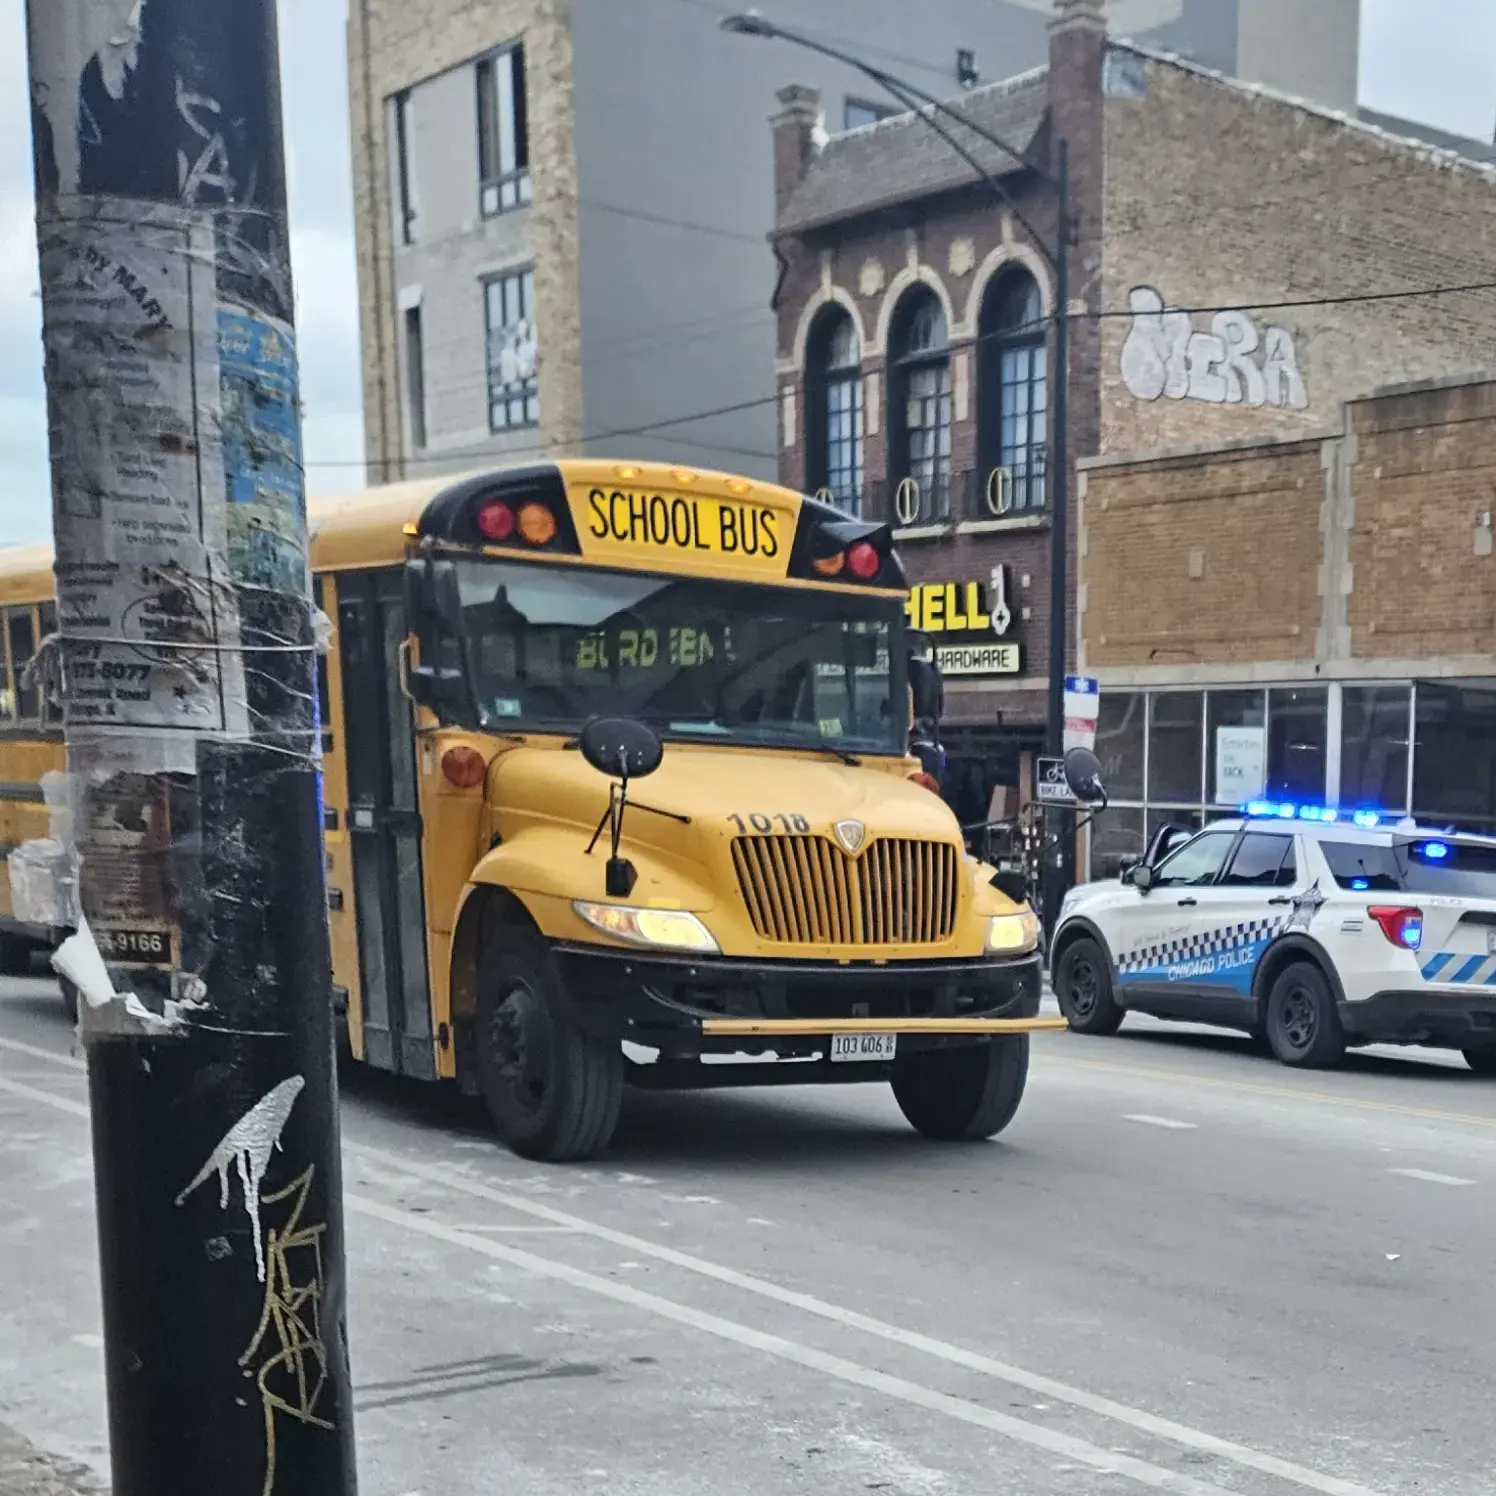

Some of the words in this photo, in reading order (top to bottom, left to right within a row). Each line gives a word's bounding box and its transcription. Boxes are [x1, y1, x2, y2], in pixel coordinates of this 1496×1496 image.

[589, 489, 710, 549] SCHOOL
[719, 506, 778, 557] BUS
[938, 649, 1010, 669] HARDWARE
[727, 812, 810, 834] 1018
[1168, 958, 1215, 982] CHICAGO
[1218, 947, 1255, 971] POLICE
[836, 1036, 857, 1054] 103
